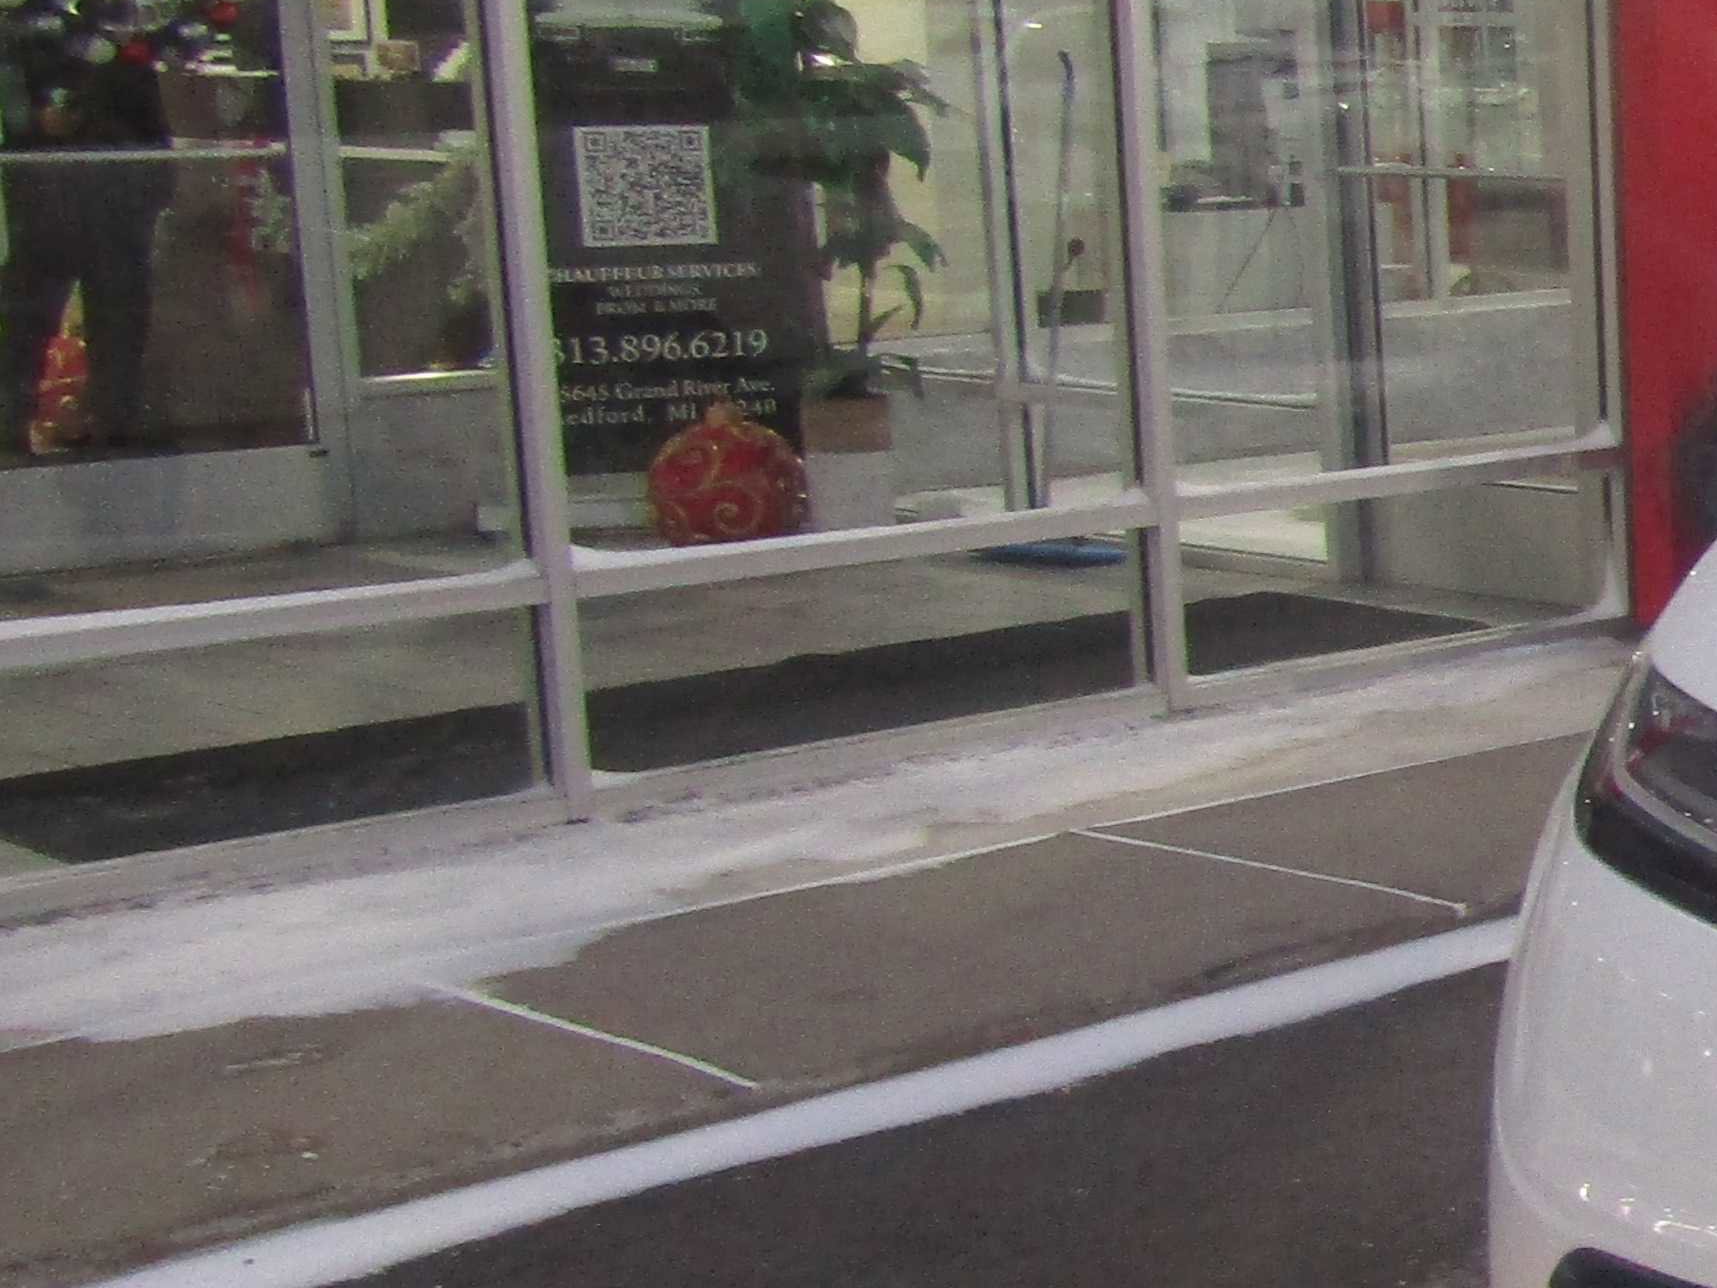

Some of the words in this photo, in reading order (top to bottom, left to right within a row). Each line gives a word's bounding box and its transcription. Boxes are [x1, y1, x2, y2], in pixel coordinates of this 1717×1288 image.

[614, 379, 680, 401] Grand
[682, 378, 731, 397] River
[735, 376, 776, 394] Ave.
